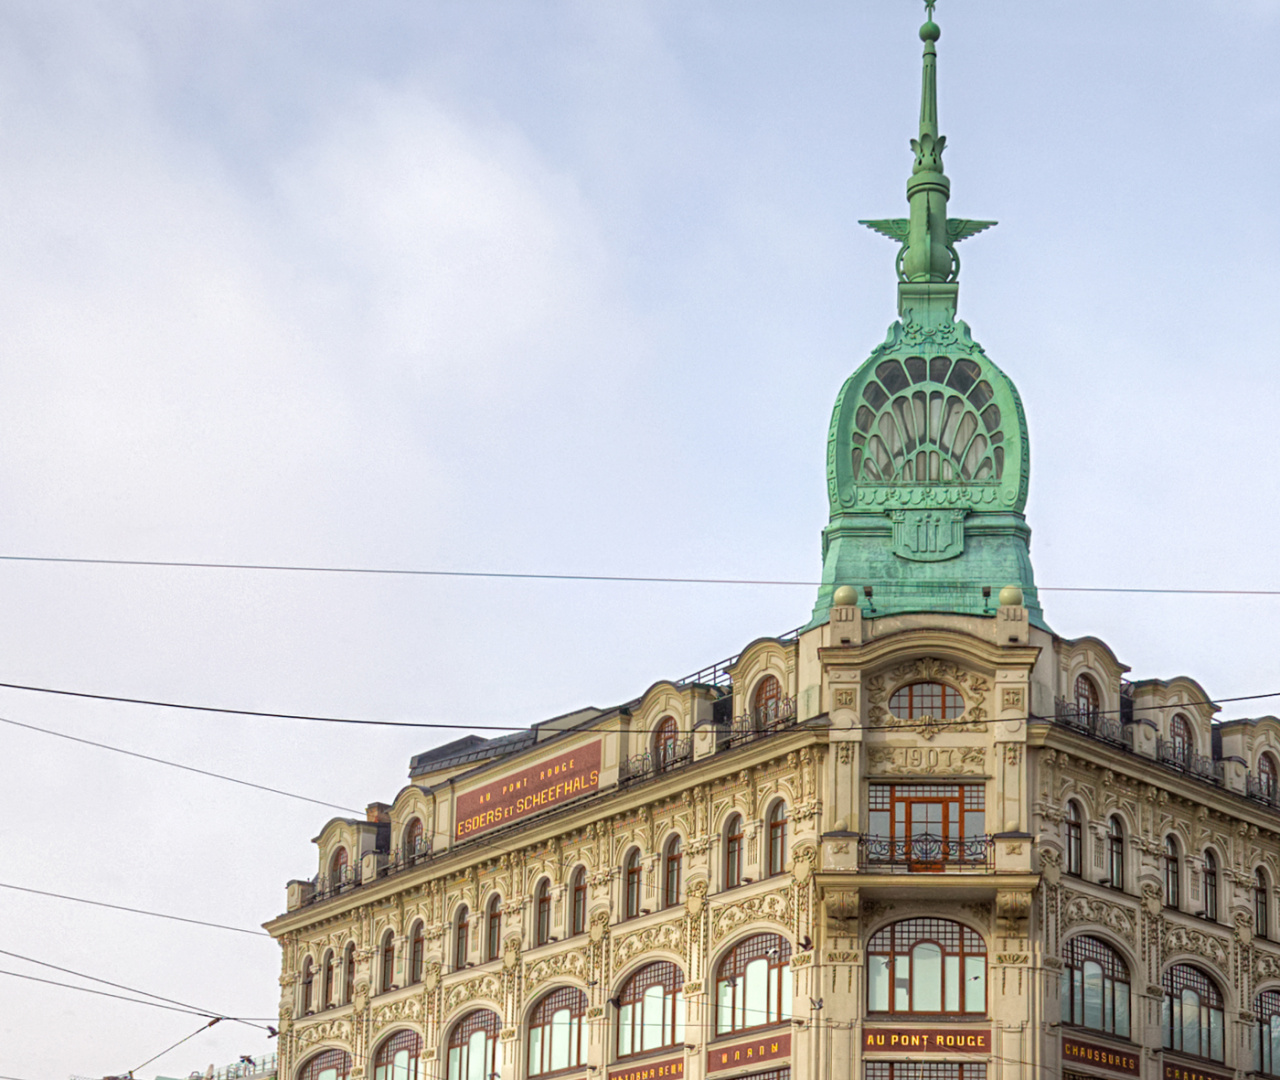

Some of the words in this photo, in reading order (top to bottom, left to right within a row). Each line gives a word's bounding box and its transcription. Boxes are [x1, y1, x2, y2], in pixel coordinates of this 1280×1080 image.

[479, 792, 491, 804] AU
[502, 778, 528, 795] PONT
[540, 759, 575, 781] ROUGE
[457, 807, 503, 836] ESDERS
[504, 806, 514, 818] ET
[516, 770, 599, 813] SCHEEFHALS
[721, 1042, 779, 1064] ШЛЯПЫ
[866, 1034, 885, 1046] AU
[890, 1034, 929, 1046] PONT
[936, 1035, 986, 1047] ROUGE
[1064, 1043, 1136, 1070] CHAUSSURES
